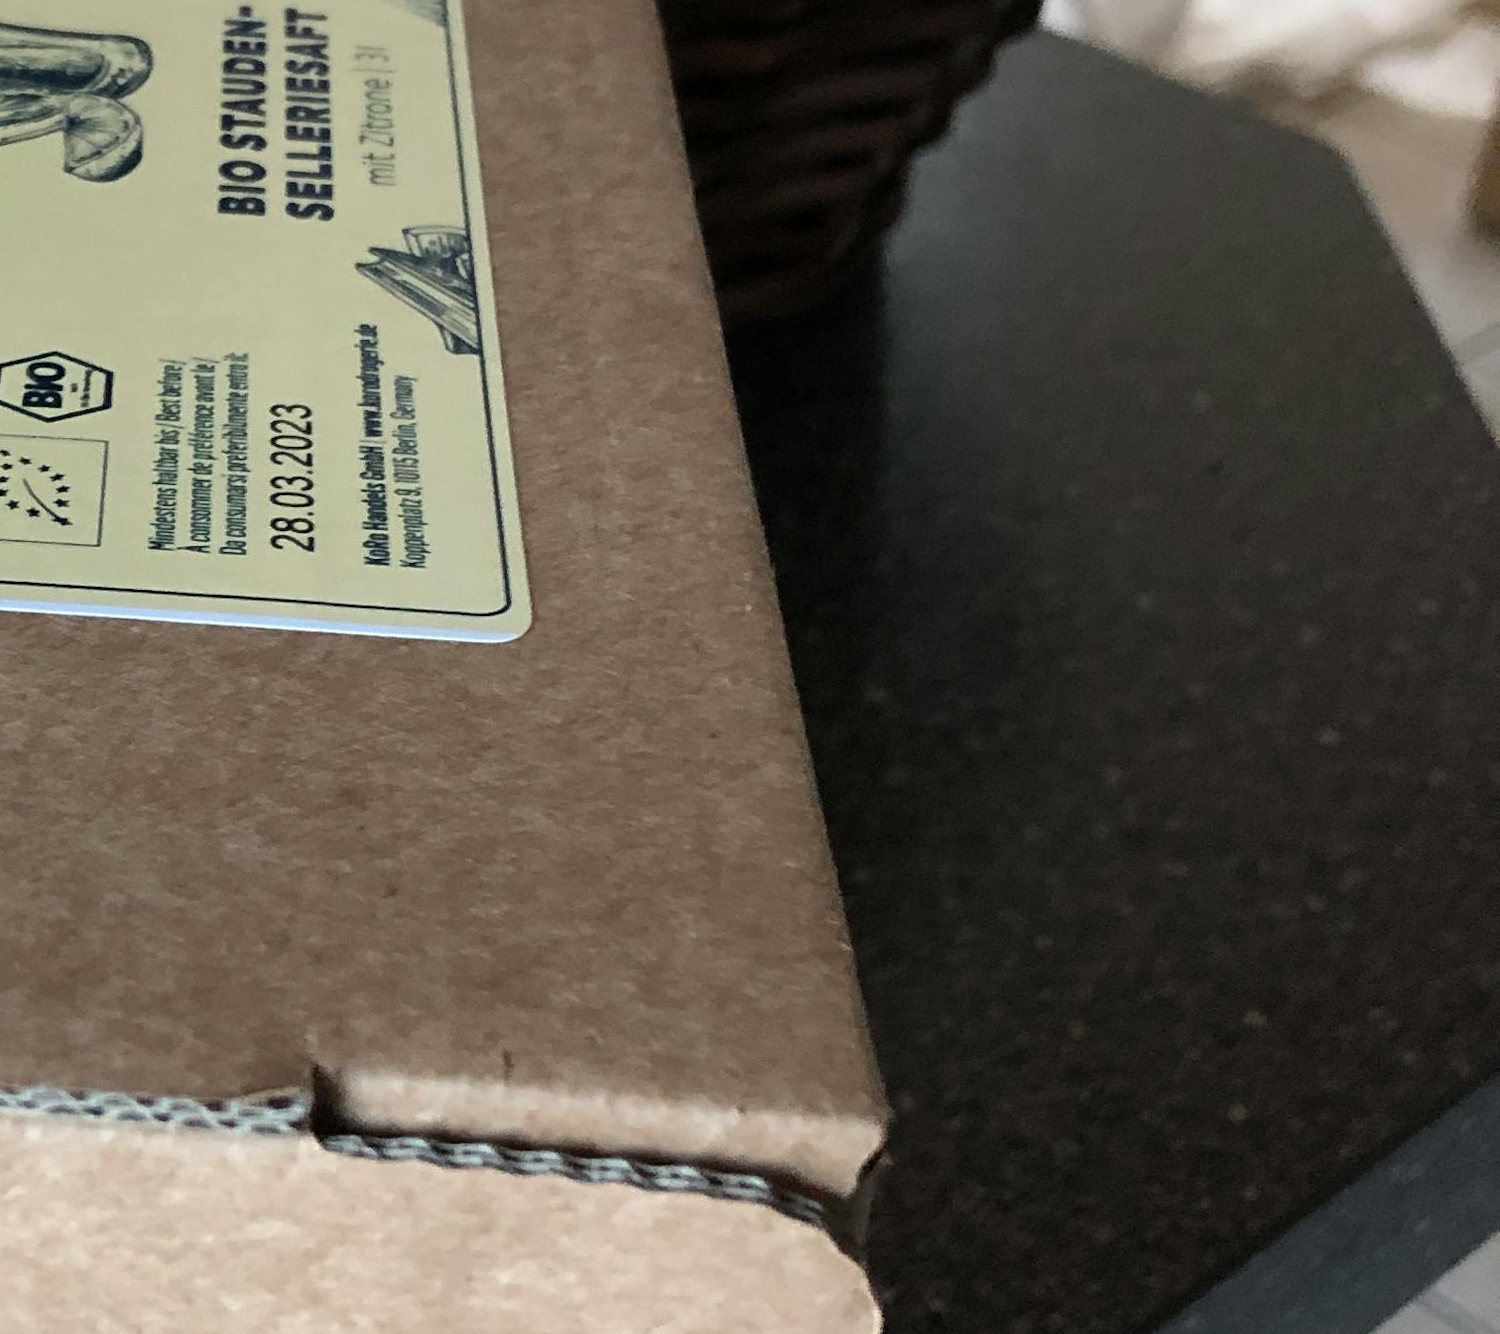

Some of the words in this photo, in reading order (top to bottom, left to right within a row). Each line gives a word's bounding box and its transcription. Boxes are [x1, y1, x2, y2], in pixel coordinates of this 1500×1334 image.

[219, 5, 266, 152] STAUDEN-
[284, 8, 334, 222] SELLERIESAFT
[358, 79, 394, 147] Zitrone
[218, 161, 266, 216] BIO
[363, 153, 396, 186] mit
[21, 359, 66, 409] BIO
[156, 364, 183, 398] before
[190, 363, 216, 373] le
[193, 374, 216, 403] avant
[225, 363, 249, 391] entro
[354, 323, 385, 438] www.korodrogerie.de
[154, 398, 182, 423] Best
[389, 375, 418, 421] Germany
[153, 429, 181, 445] bis
[187, 403, 218, 461] préférence
[220, 391, 251, 473] preferibilmente
[151, 446, 180, 486] haltbar
[186, 461, 214, 476] de
[268, 403, 316, 553] 28.03.2023
[358, 445, 386, 481] GmbH
[392, 457, 421, 484] 10115
[147, 487, 178, 552] Mindestens
[189, 477, 213, 543] consommer
[222, 473, 248, 538] consumarsi
[360, 482, 389, 531] Handels
[218, 539, 248, 556] Da
[362, 532, 391, 567] KoRo
[396, 497, 431, 569] Koppenplatz
